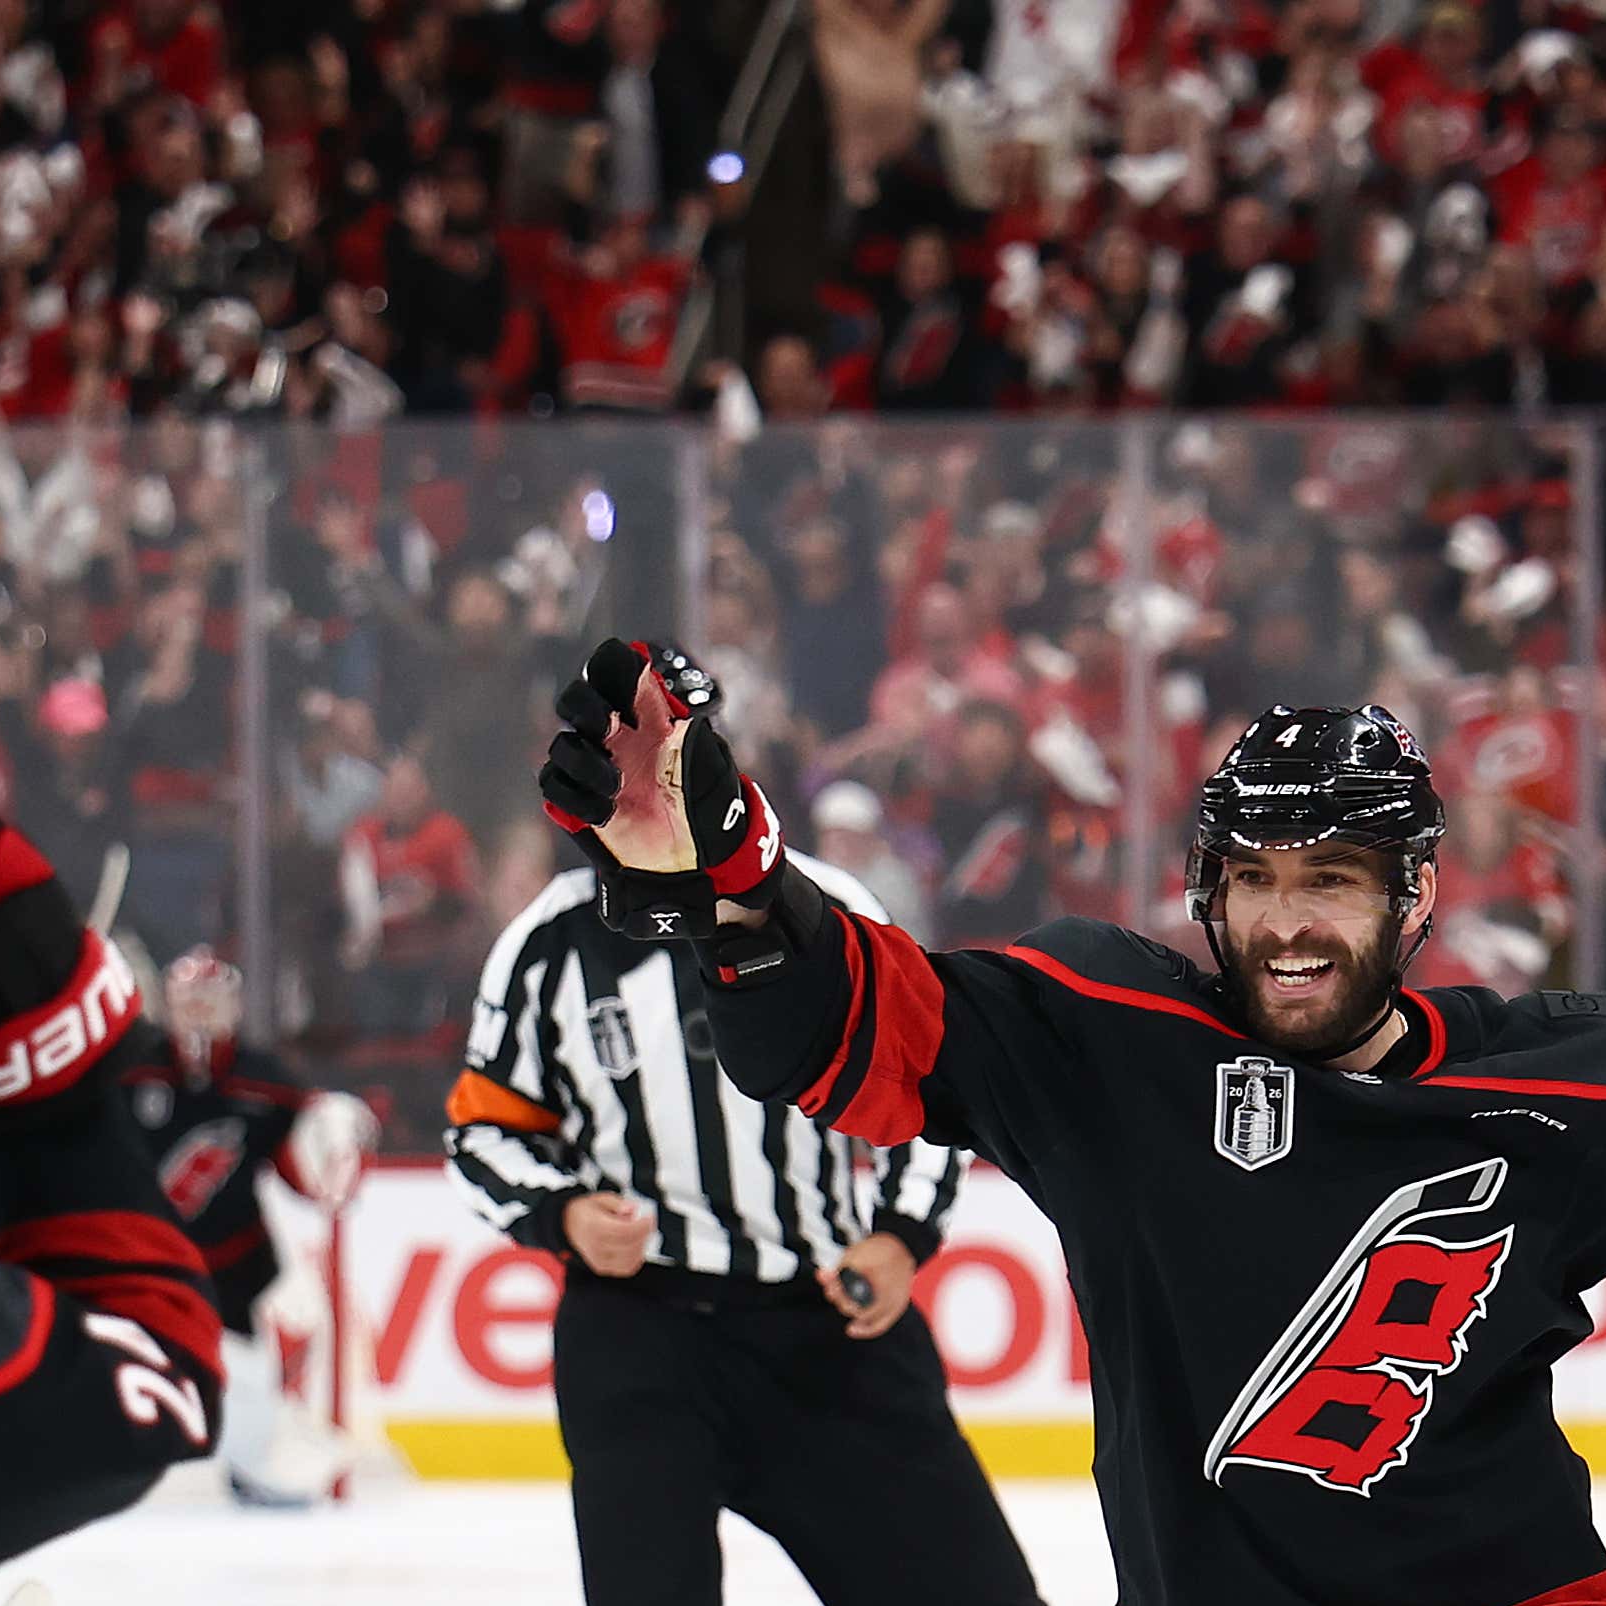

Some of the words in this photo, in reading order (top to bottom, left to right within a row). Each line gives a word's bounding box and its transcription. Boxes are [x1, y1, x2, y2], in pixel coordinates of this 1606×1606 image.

[1275, 723, 1303, 748] 4
[1229, 1086, 1243, 1097] 20
[1269, 1088, 1282, 1099] 26
